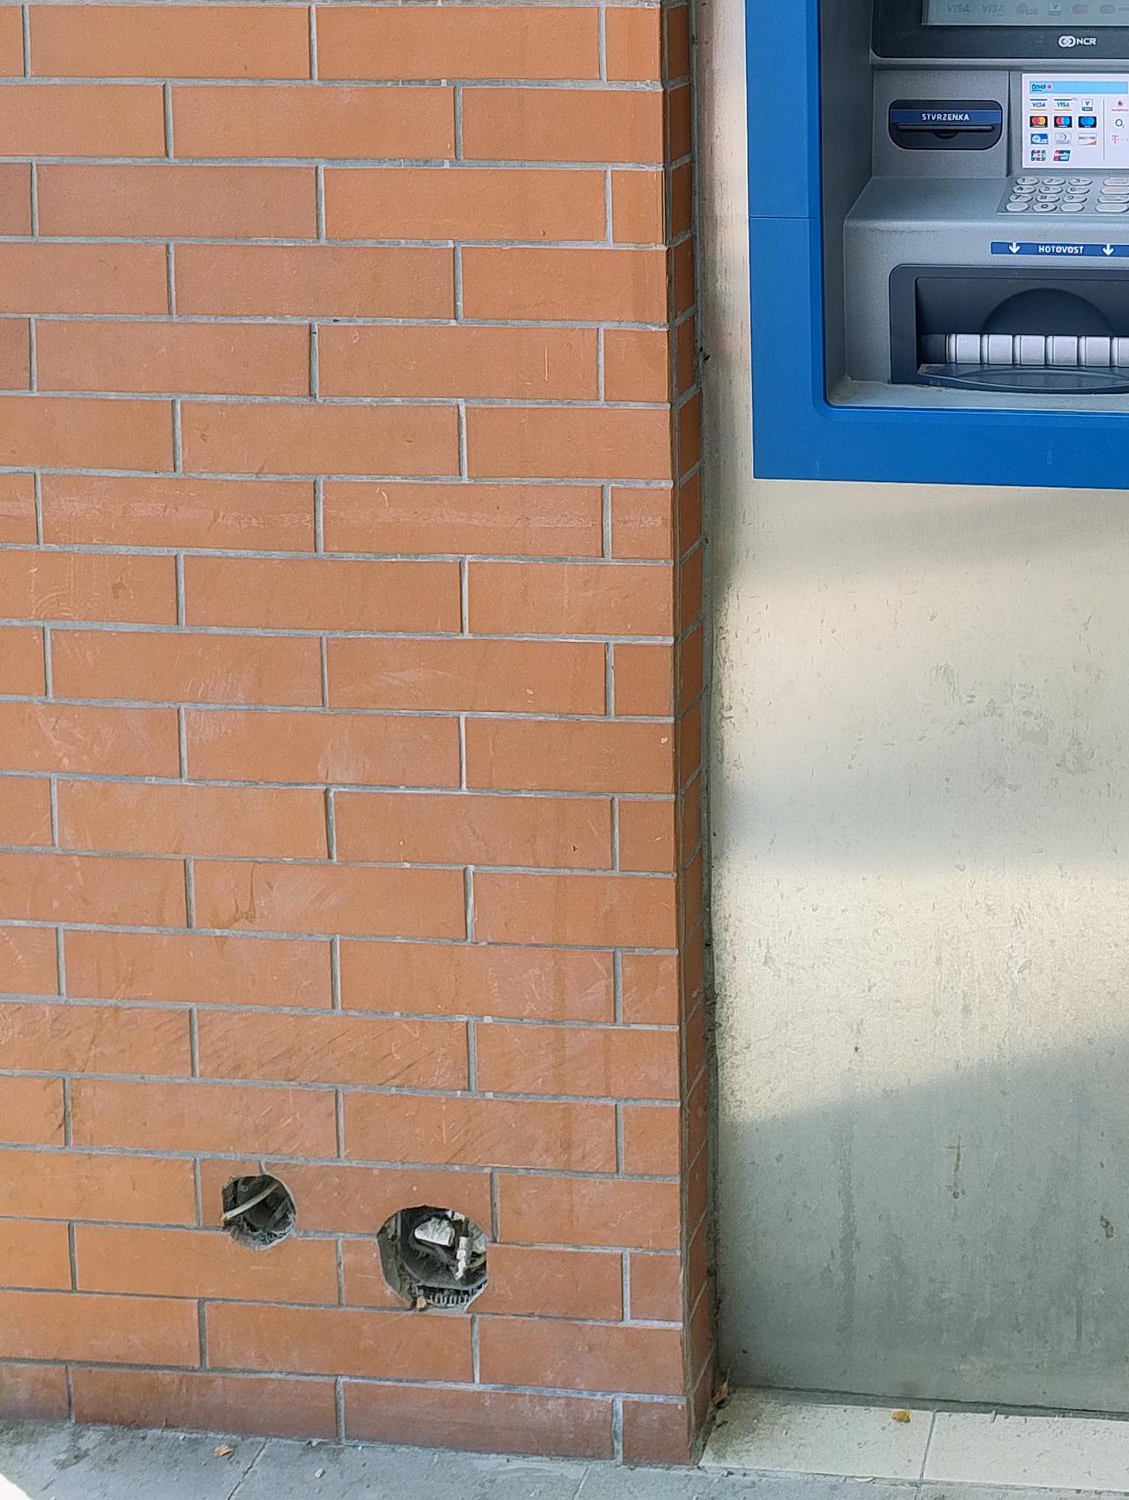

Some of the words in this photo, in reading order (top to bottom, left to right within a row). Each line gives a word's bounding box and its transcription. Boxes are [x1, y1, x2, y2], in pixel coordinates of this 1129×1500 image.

[946, 3, 970, 13] VISA
[1076, 37, 1097, 46] NCR
[921, 113, 970, 121] STVRZENKA
[1038, 244, 1085, 254] HOTOVOST
